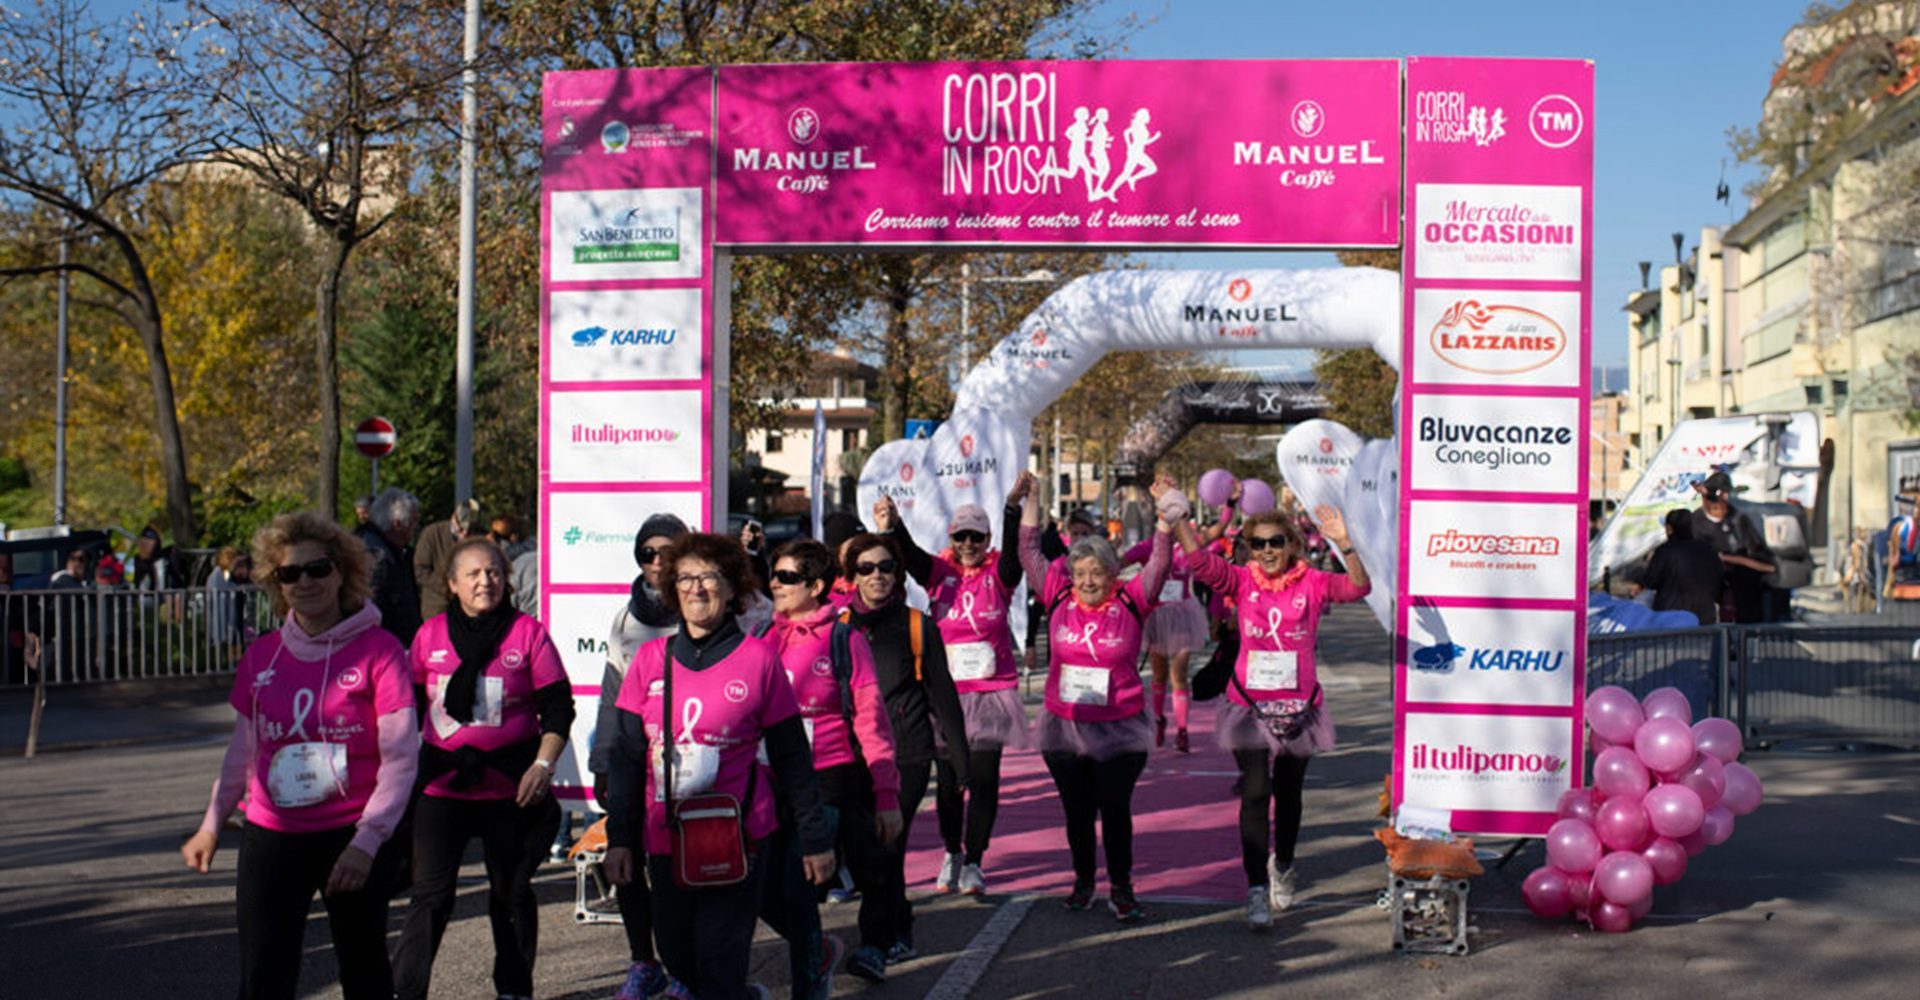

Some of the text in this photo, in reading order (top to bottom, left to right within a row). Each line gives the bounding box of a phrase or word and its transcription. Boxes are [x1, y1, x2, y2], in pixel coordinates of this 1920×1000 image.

[943, 72, 1056, 142] CORRI
[1416, 91, 1465, 121] CORRI
[1417, 122, 1466, 142] IN ROSA
[1538, 112, 1573, 131] TM
[733, 147, 876, 171] MANUEL
[1234, 140, 1384, 165] MANUEL
[943, 145, 1062, 195] IN ROSA
[865, 208, 1241, 232] Corriamo insieme contro il tumore al seno
[1445, 200, 1531, 222] Mercato
[1424, 223, 1574, 244] OCCASIONI
[1185, 304, 1297, 322] MANUEL
[611, 330, 676, 345] KARHU
[1441, 333, 1556, 351] LAZZARIS
[571, 424, 662, 445] il tulipano
[1420, 417, 1572, 444] Bluvacanze
[1436, 445, 1552, 470] Conegliano
[1427, 530, 1560, 556] piovesana
[1450, 561, 1485, 569] biscotti
[1496, 561, 1536, 570] crackers
[1469, 649, 1563, 671] KARHU
[1412, 744, 1542, 774] il tulipano
